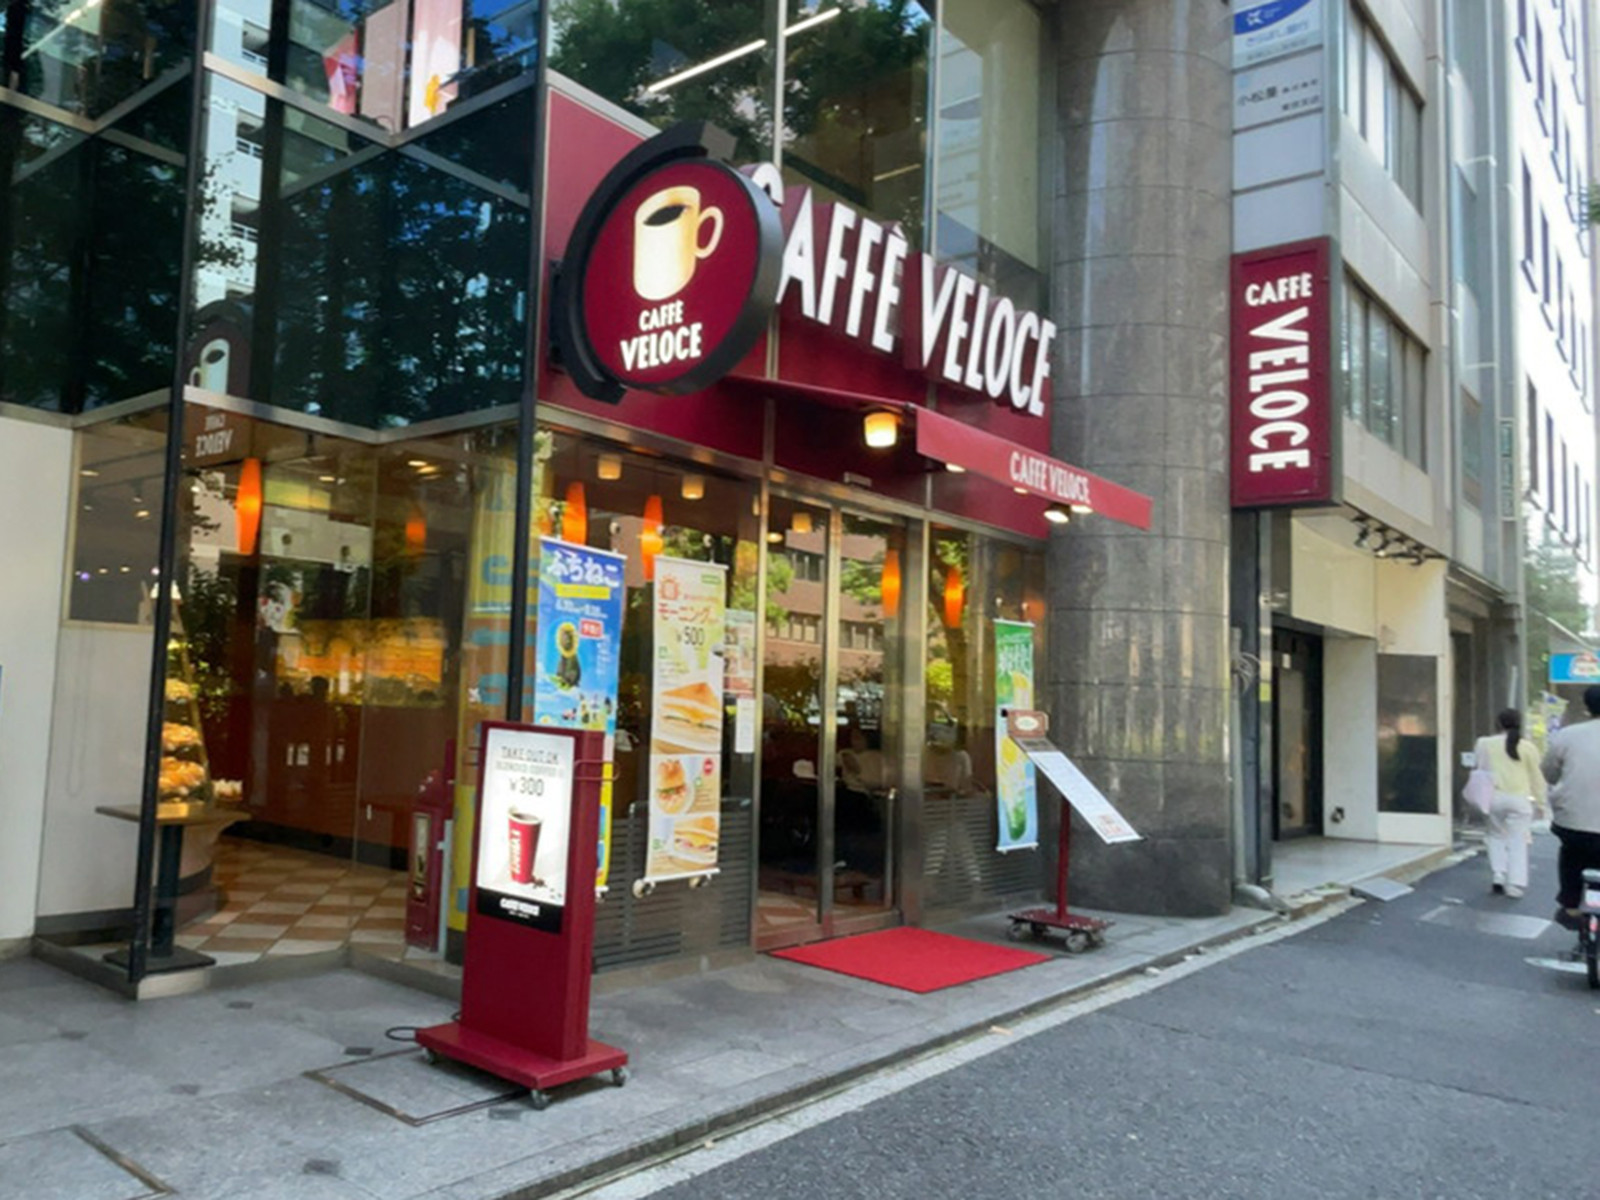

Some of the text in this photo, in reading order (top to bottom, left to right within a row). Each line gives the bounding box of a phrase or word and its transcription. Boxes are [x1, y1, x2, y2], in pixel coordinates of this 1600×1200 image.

[620, 322, 702, 372] VELOCE
[921, 252, 1057, 417] VELOCE
[1248, 306, 1310, 473] VELOCE
[1049, 464, 1091, 505] VELOCE
